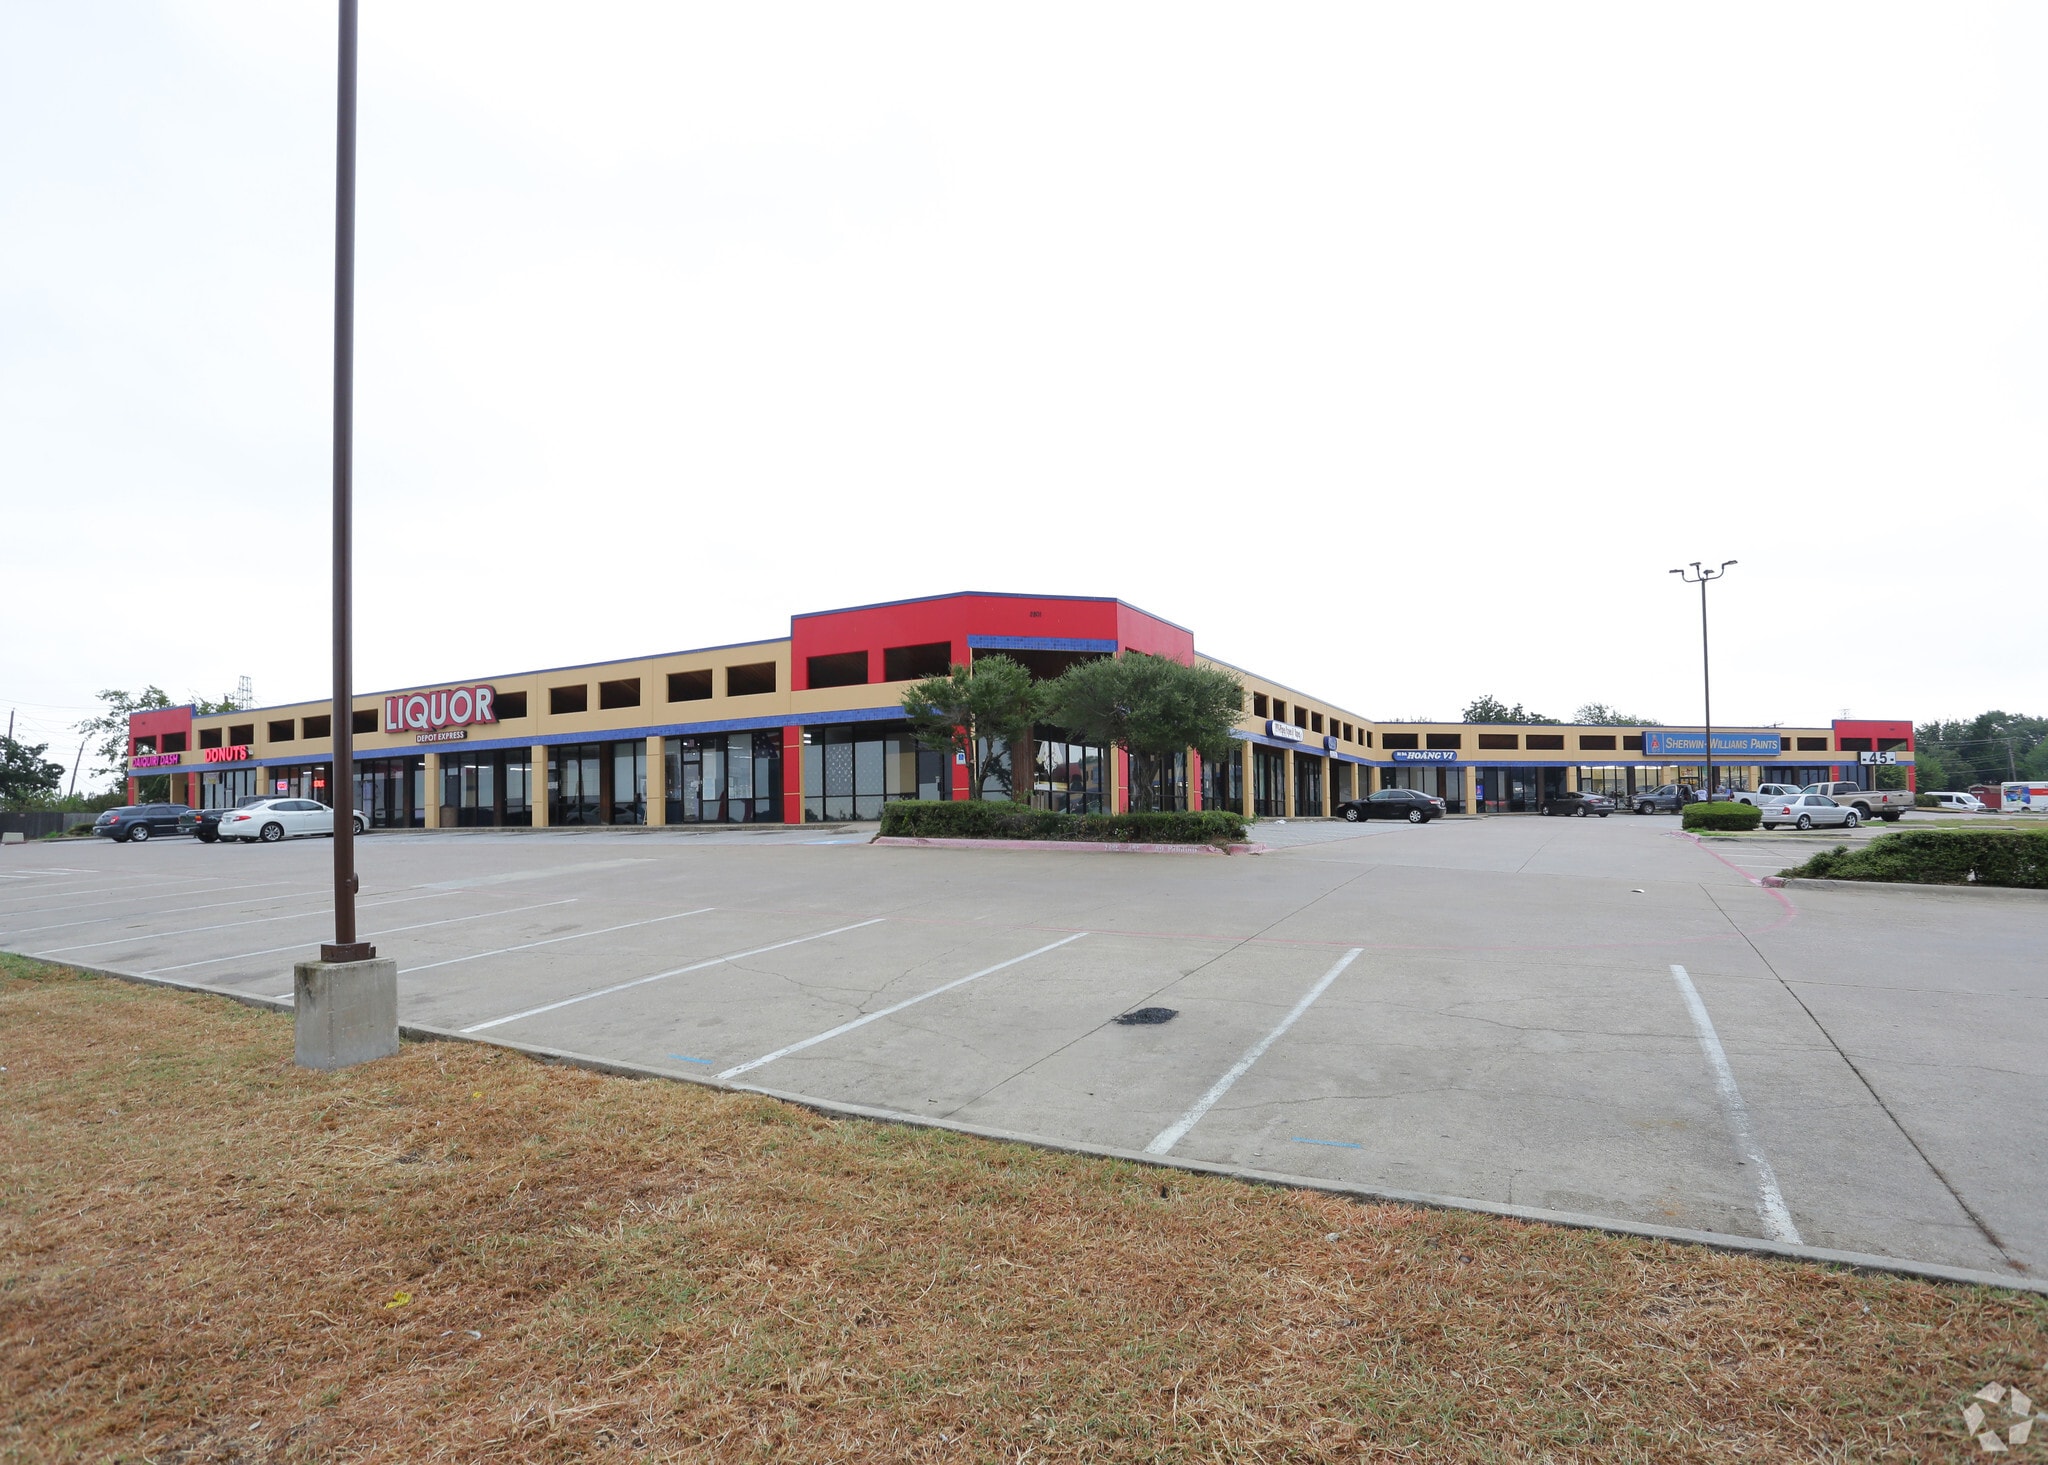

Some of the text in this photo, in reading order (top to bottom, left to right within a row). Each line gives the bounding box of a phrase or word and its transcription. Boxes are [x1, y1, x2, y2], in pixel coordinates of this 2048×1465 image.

[386, 688, 492, 730] LIQUOR
[416, 731, 465, 743] DEPOT EXPRESS
[1750, 738, 1778, 750] PAINTS
[132, 754, 179, 768] DAIQUIRI DASH
[204, 746, 247, 763] DONUTS
